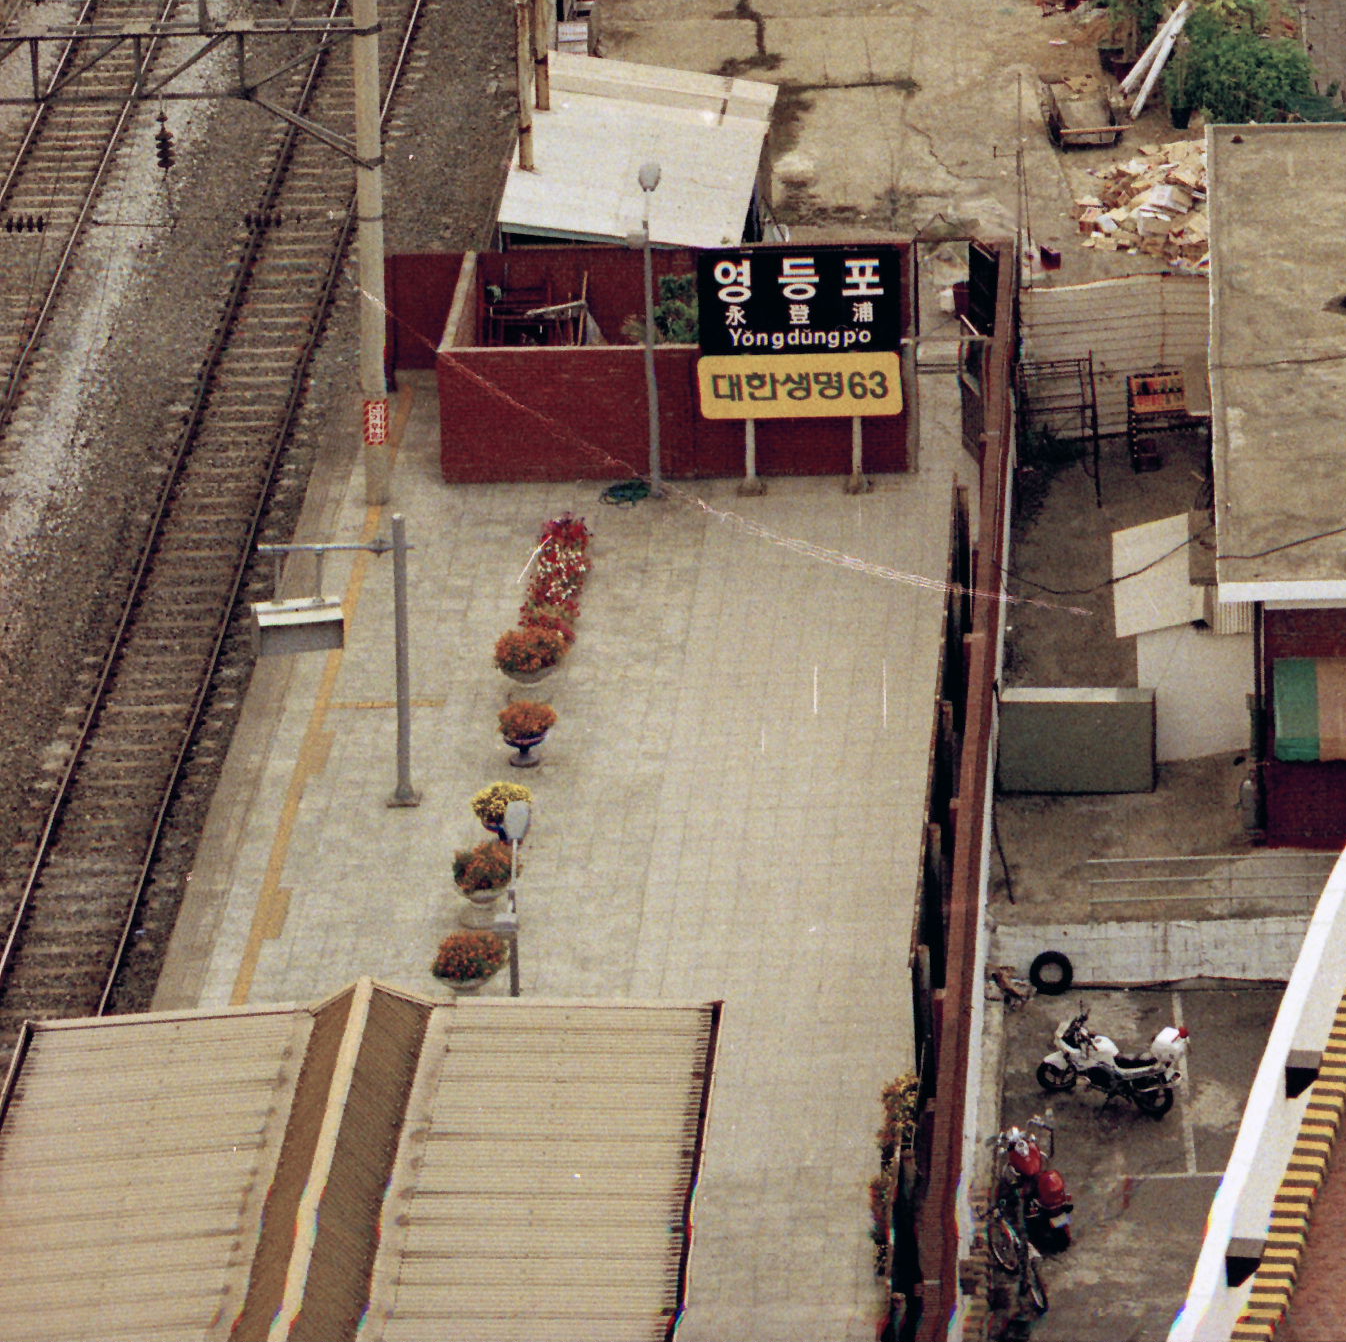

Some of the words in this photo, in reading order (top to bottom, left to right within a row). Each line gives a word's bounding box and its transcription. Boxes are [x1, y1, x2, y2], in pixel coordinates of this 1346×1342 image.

[713, 256, 885, 304] 영등포
[724, 302, 875, 326] 永登浦
[711, 370, 889, 403] 대한생명63
